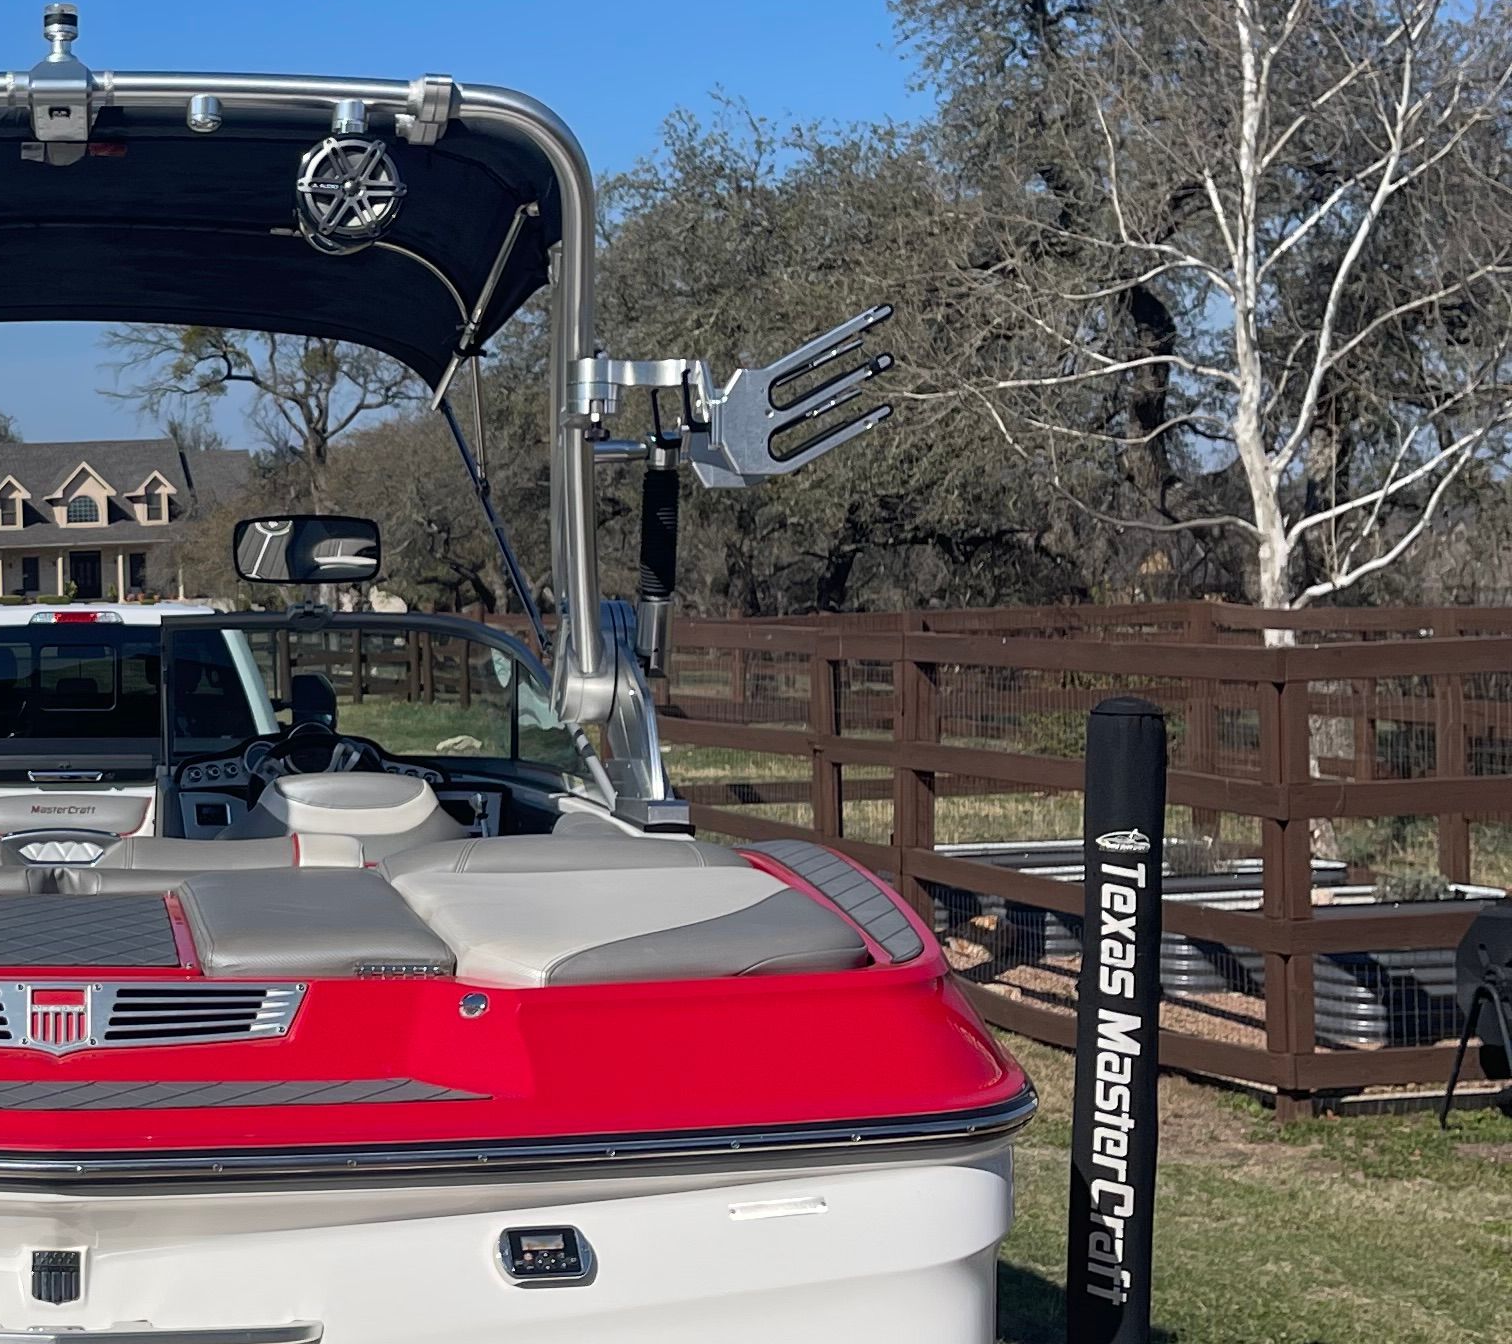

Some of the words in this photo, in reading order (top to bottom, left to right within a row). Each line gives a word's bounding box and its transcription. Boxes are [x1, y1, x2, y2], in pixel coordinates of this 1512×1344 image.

[30, 805, 96, 815] MasterCraft
[1099, 862, 1146, 999] Texas
[1087, 1007, 1142, 1306] MasterCraft
